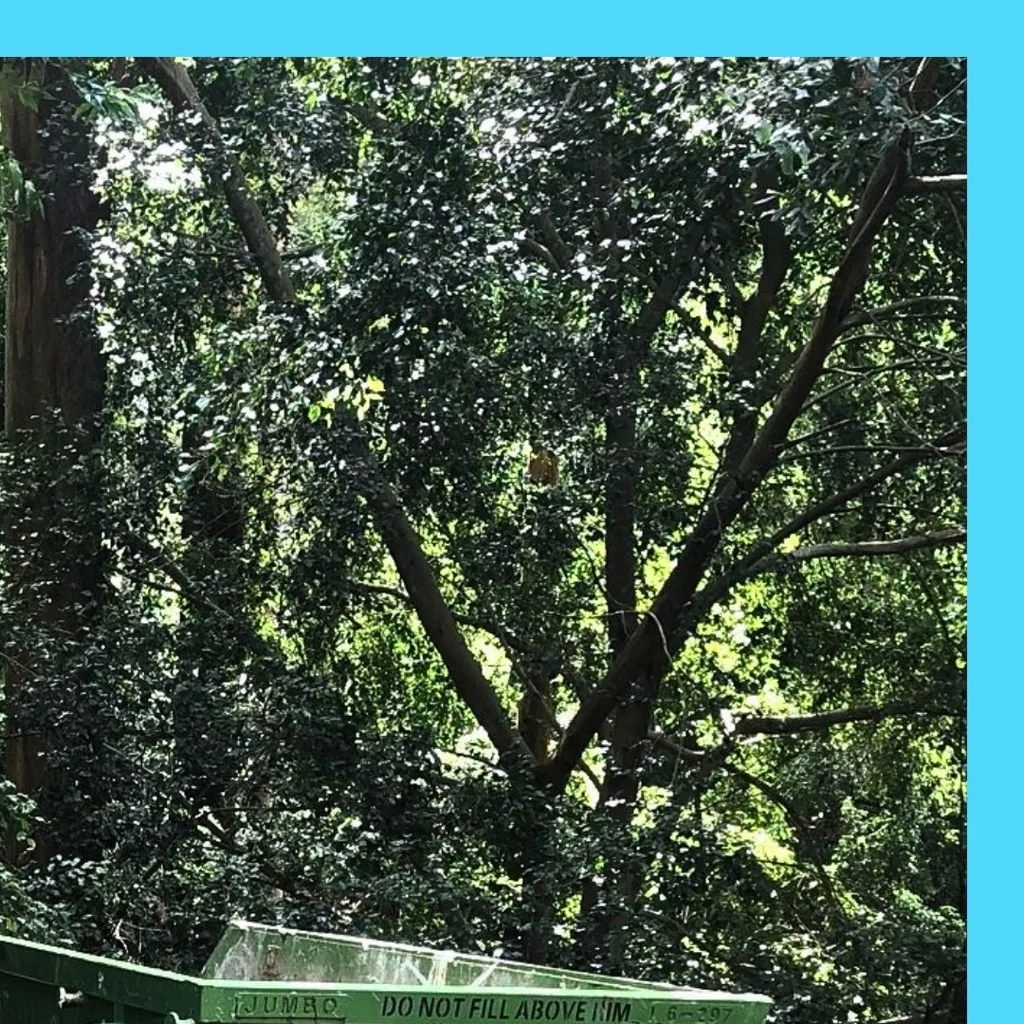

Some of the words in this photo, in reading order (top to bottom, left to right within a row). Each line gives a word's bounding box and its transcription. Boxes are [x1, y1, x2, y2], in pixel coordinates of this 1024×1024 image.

[245, 995, 337, 1014] JUMBO
[382, 996, 413, 1016] DO
[418, 998, 466, 1018] NOT
[469, 999, 509, 1019] FILL
[514, 1000, 587, 1021] ABOVE
